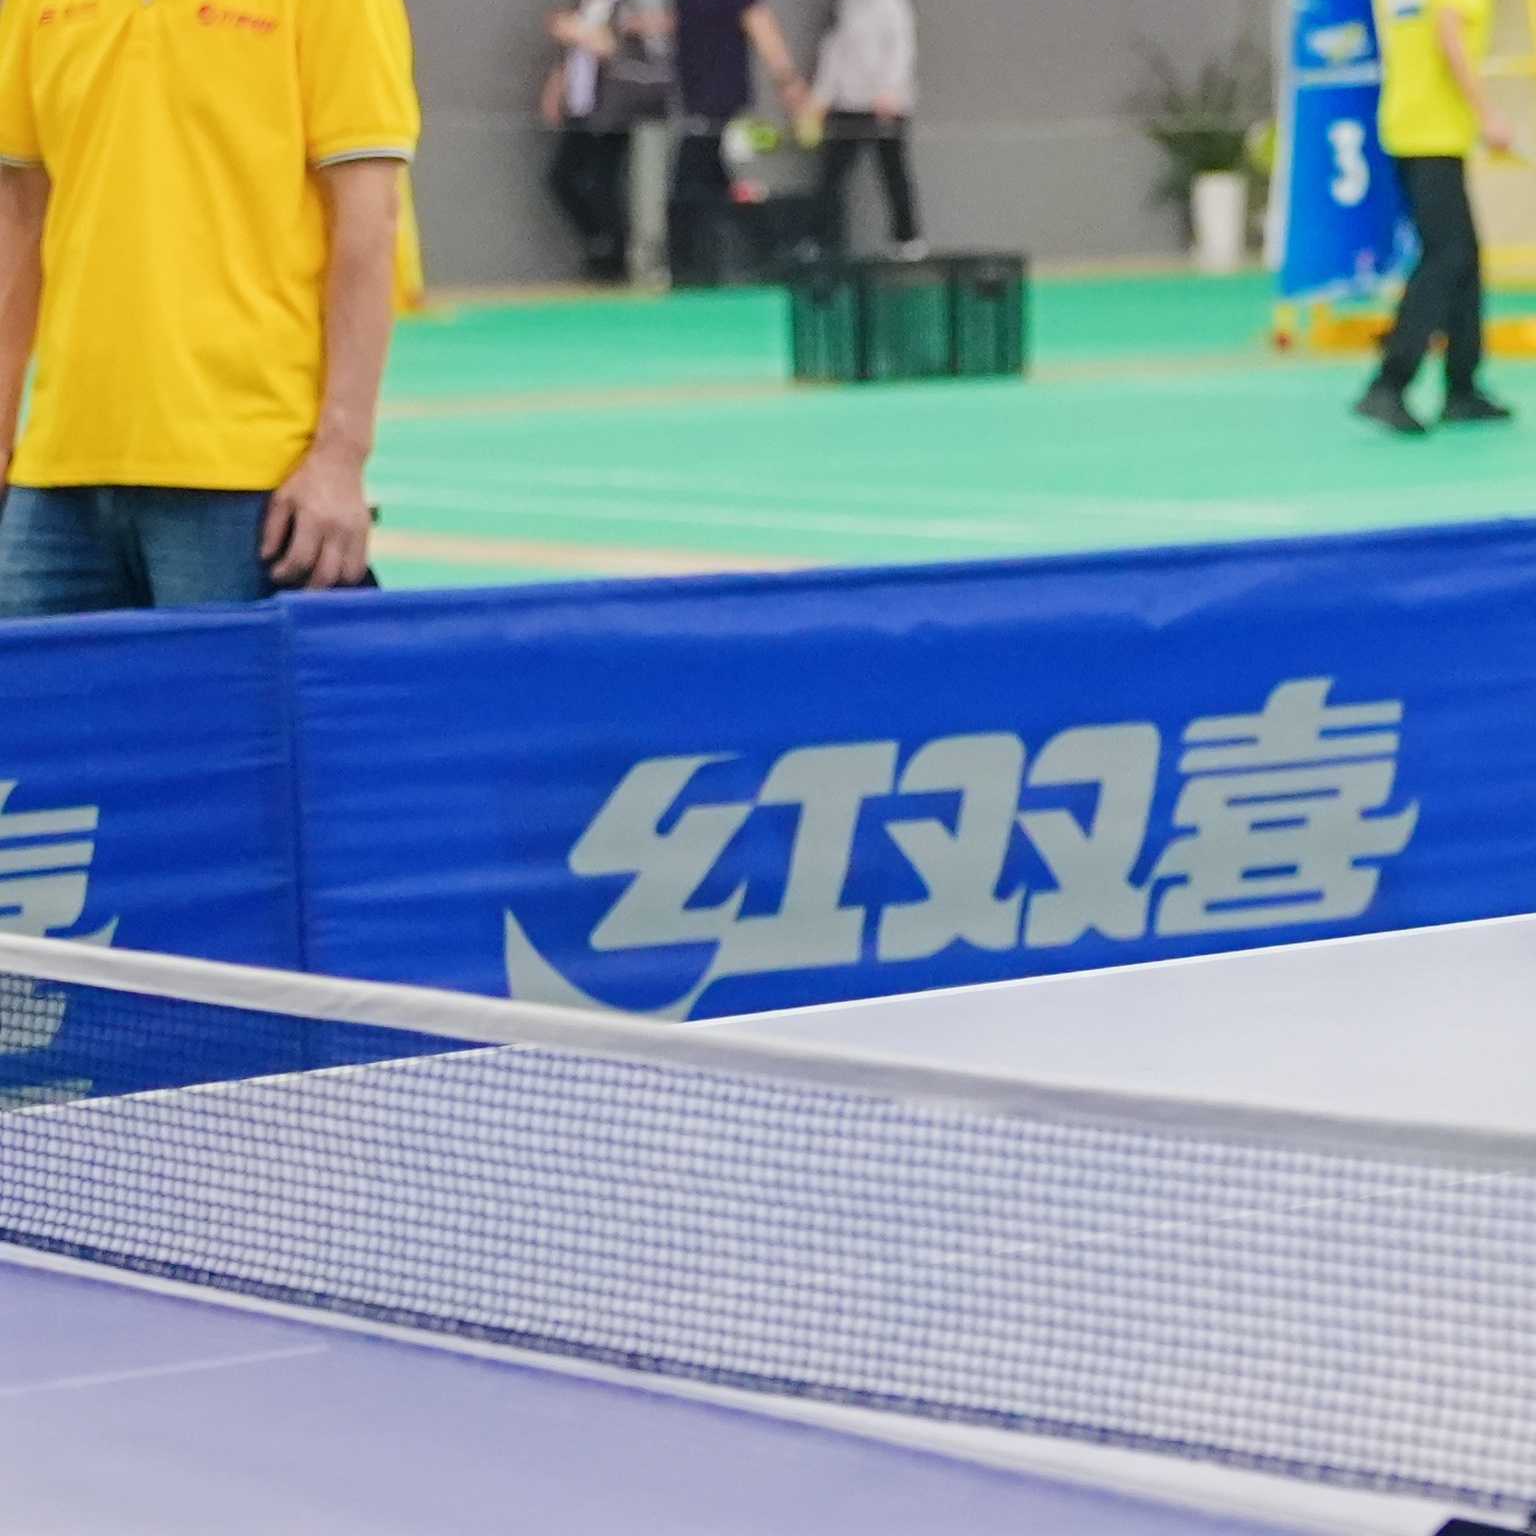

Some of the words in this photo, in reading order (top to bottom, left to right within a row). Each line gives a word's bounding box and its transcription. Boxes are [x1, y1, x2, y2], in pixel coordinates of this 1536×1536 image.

[1327, 119, 1370, 207] 3
[506, 676, 1419, 1024] 红双喜
